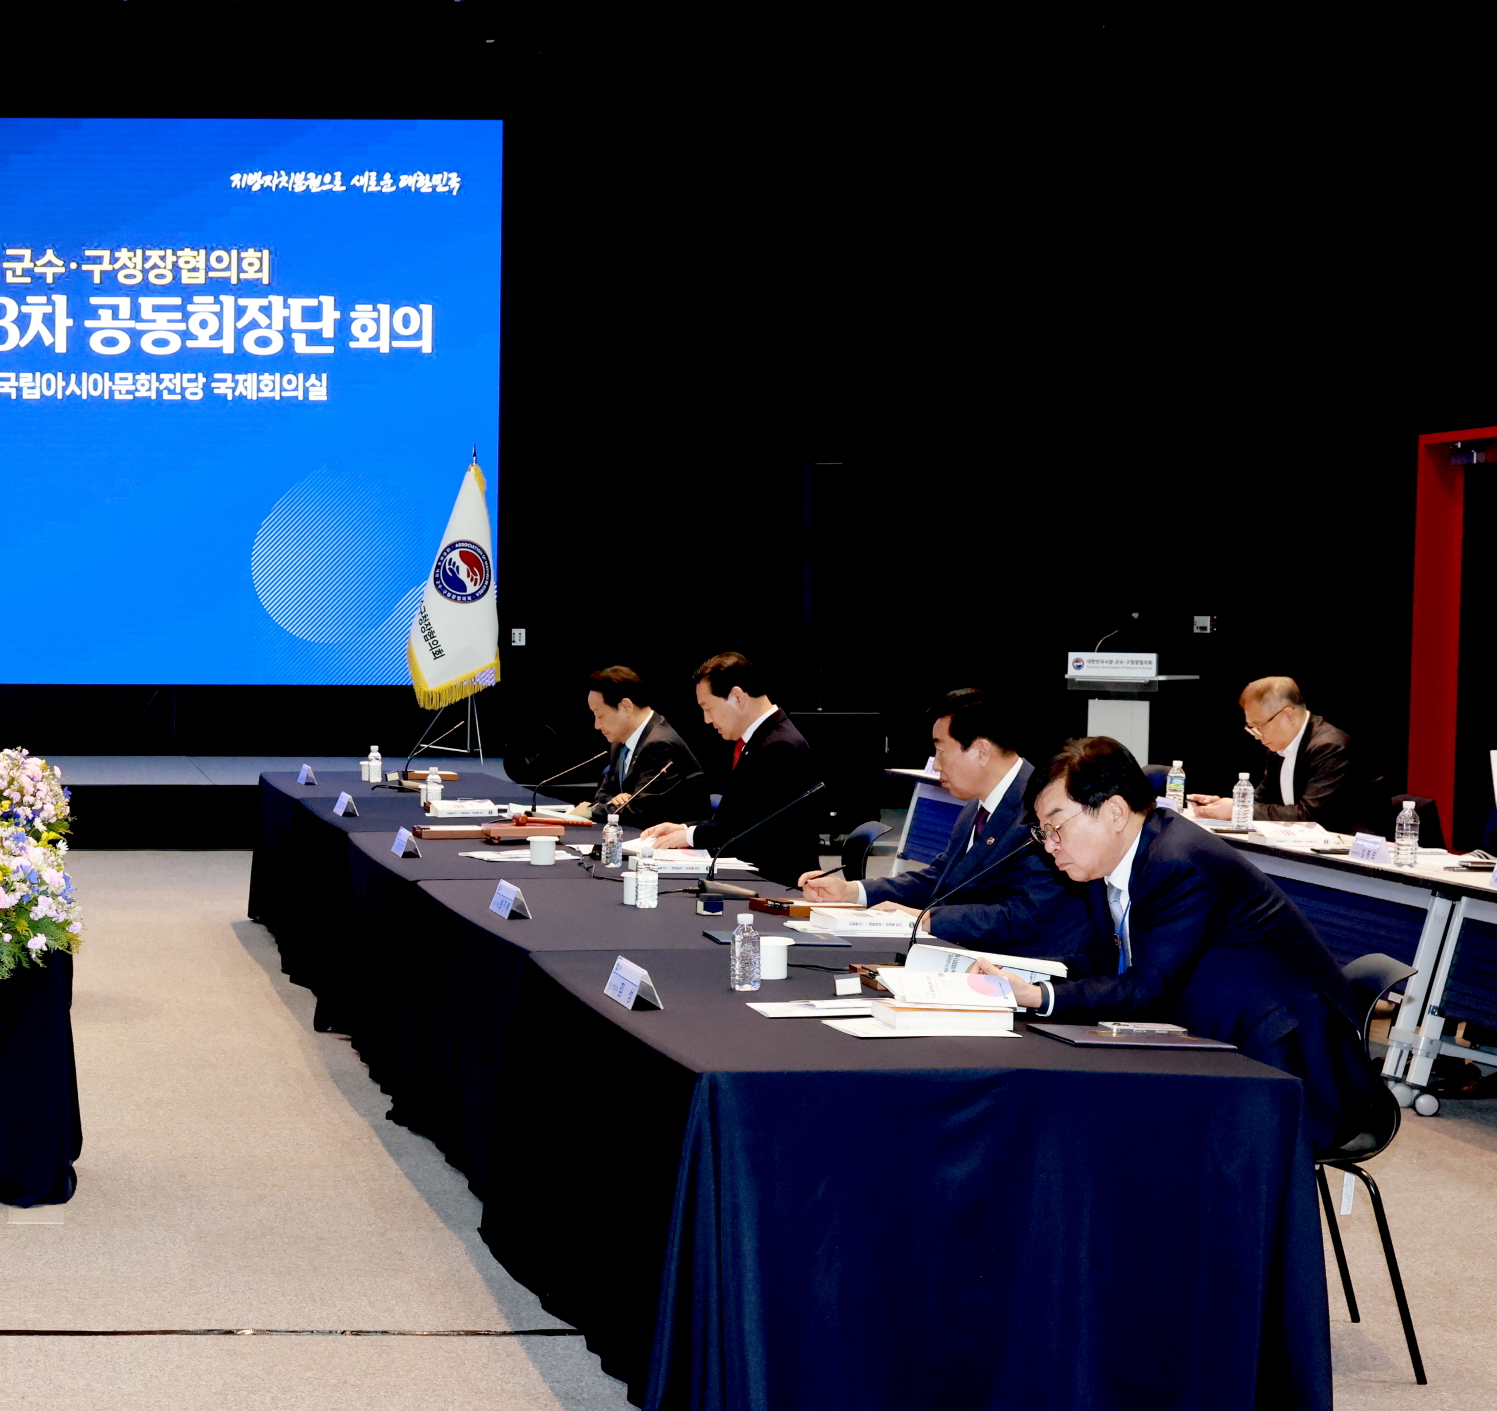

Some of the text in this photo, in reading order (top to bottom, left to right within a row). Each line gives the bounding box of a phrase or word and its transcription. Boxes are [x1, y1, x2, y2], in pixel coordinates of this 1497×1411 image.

[230, 171, 462, 195] 지방자치분권으로 새로운 대한민국
[84, 294, 340, 356] 공동회장단
[349, 303, 433, 354] 회의
[211, 372, 328, 401] 국제회의실
